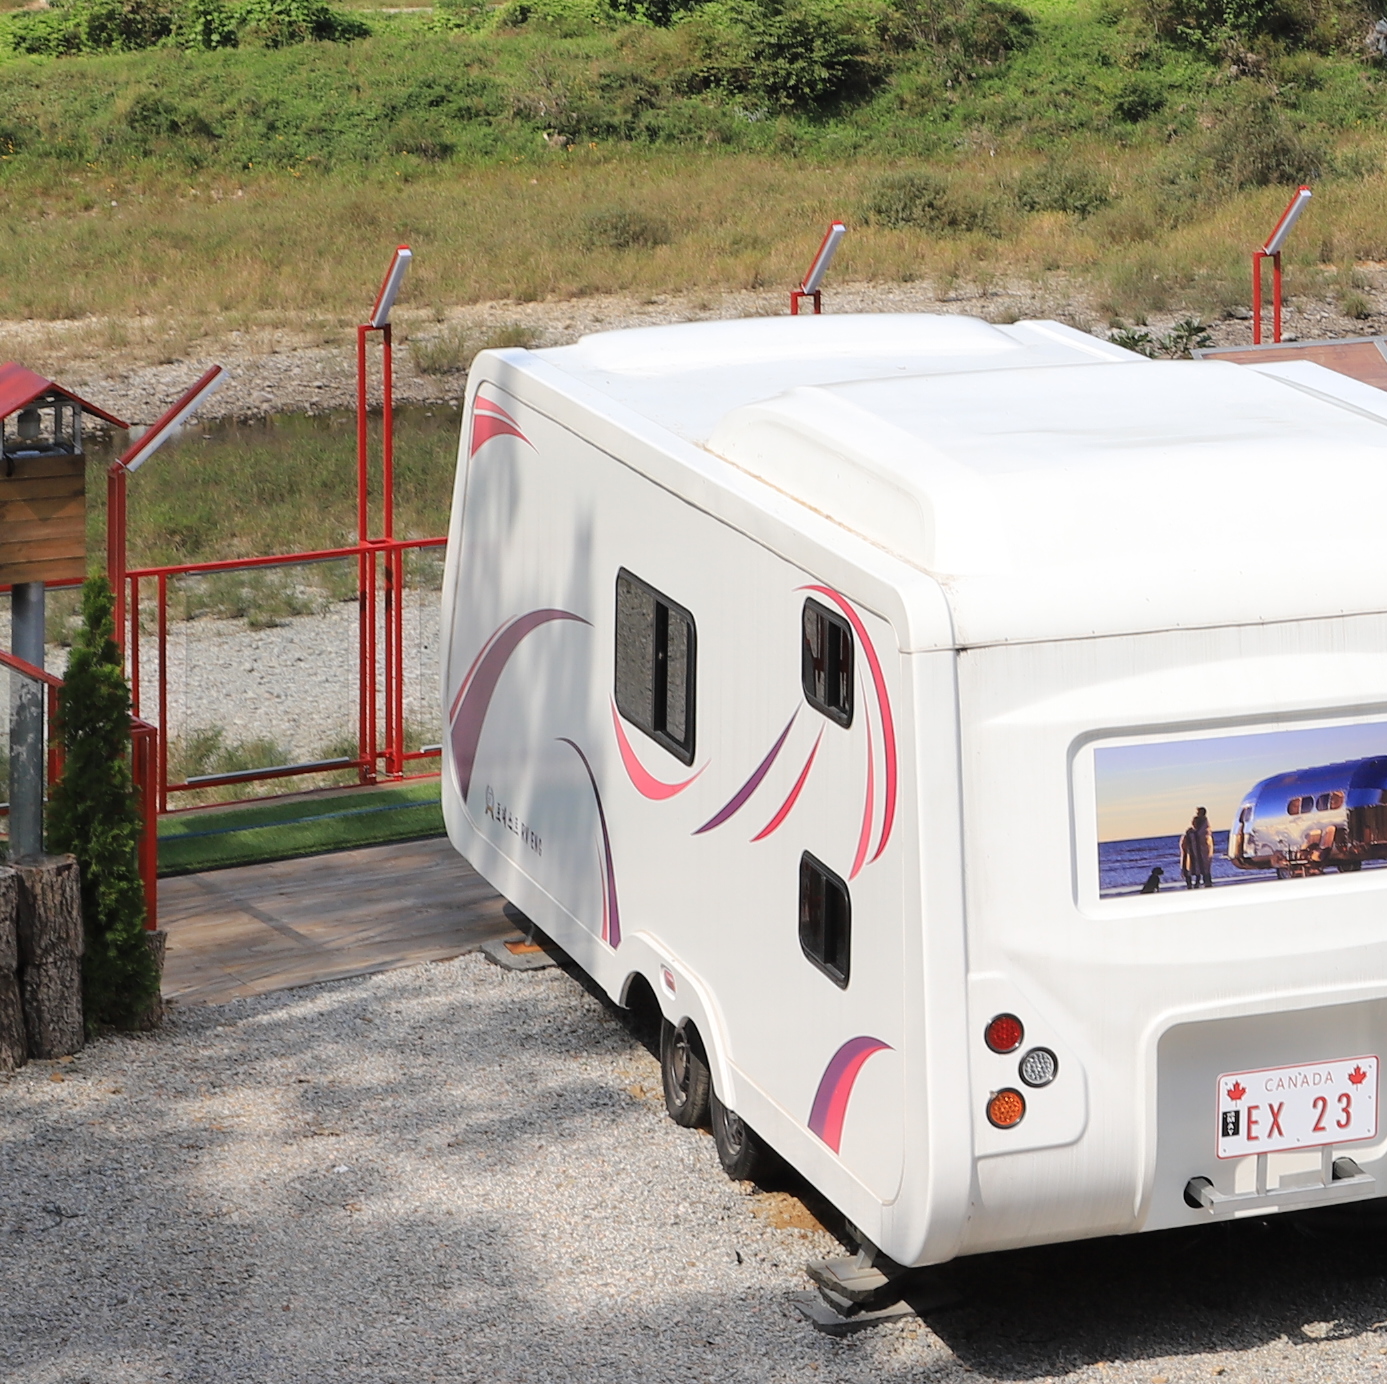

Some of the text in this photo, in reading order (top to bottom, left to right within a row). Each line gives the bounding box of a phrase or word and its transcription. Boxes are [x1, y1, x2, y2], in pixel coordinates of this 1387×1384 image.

[1264, 1070, 1334, 1092] CANADA
[1246, 1092, 1352, 1142] EX 23
